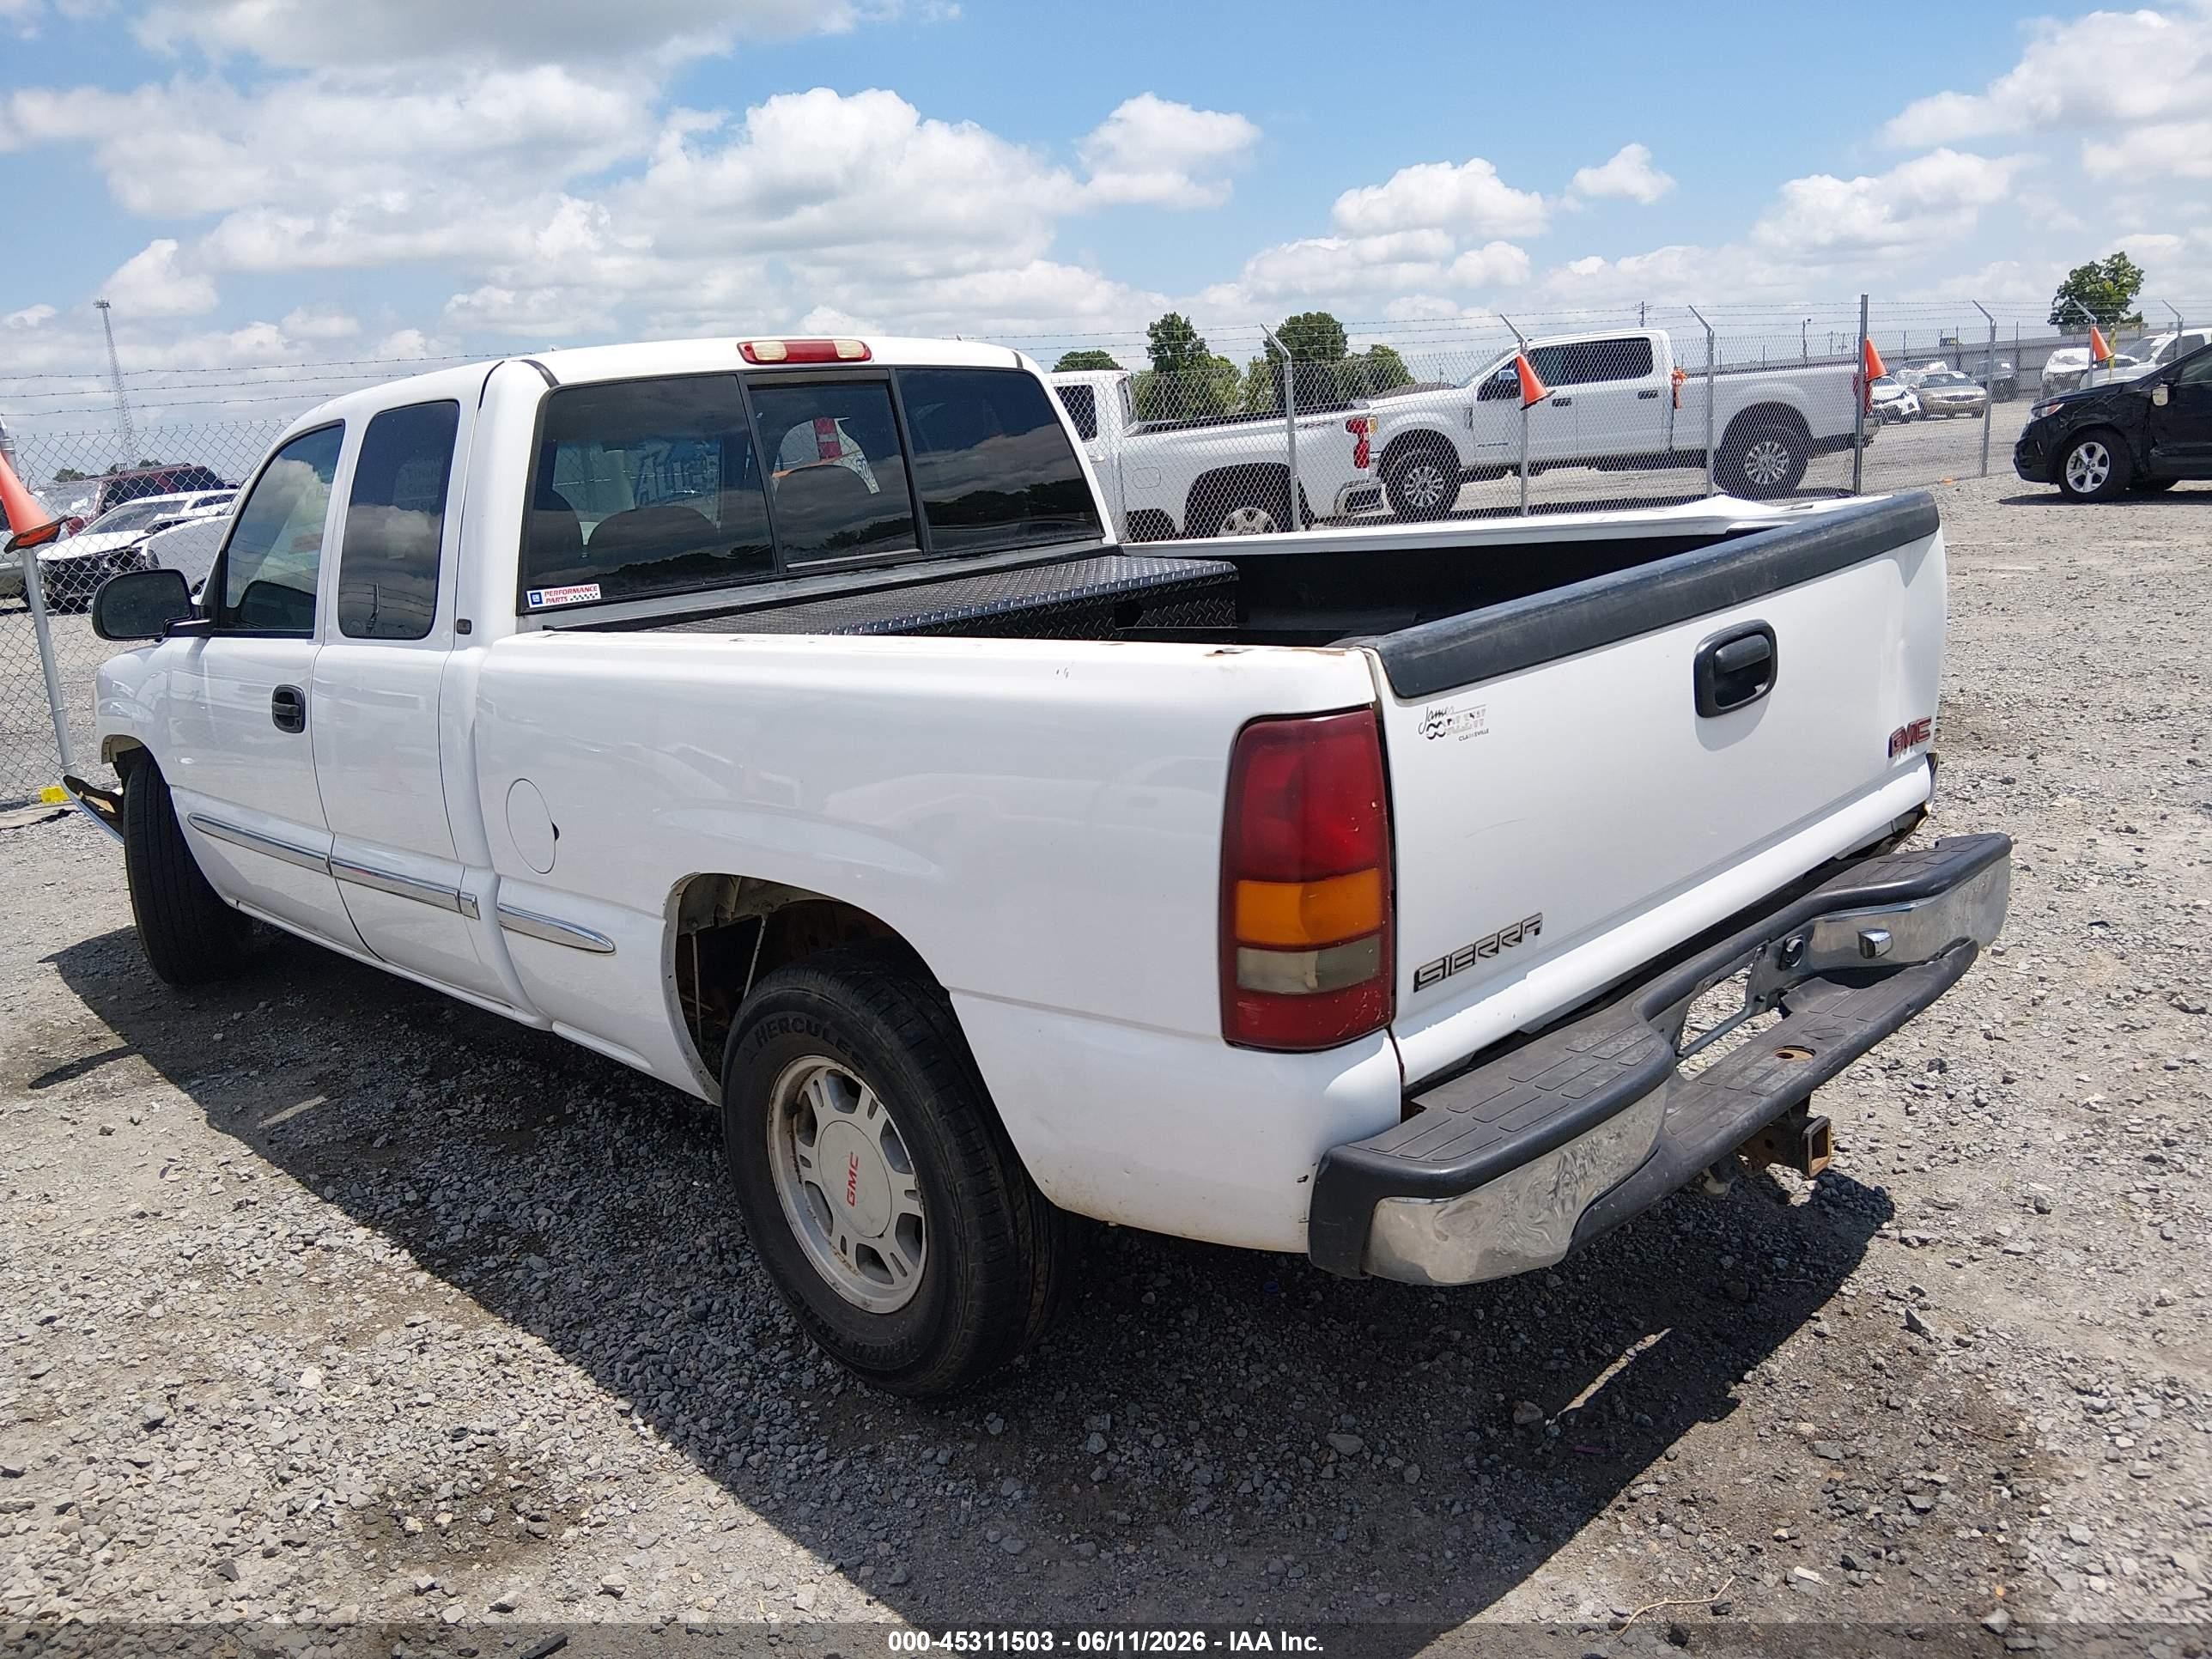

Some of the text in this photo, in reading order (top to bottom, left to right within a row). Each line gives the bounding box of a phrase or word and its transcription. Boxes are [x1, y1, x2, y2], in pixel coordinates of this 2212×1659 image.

[544, 586, 598, 597] PERFORMANCE
[545, 596, 568, 605] PARTS
[1888, 715, 1932, 758] GMC
[1413, 912, 1543, 993] SIERRA
[754, 1017, 867, 1072] HERCULES
[847, 1151, 859, 1207] GMC
